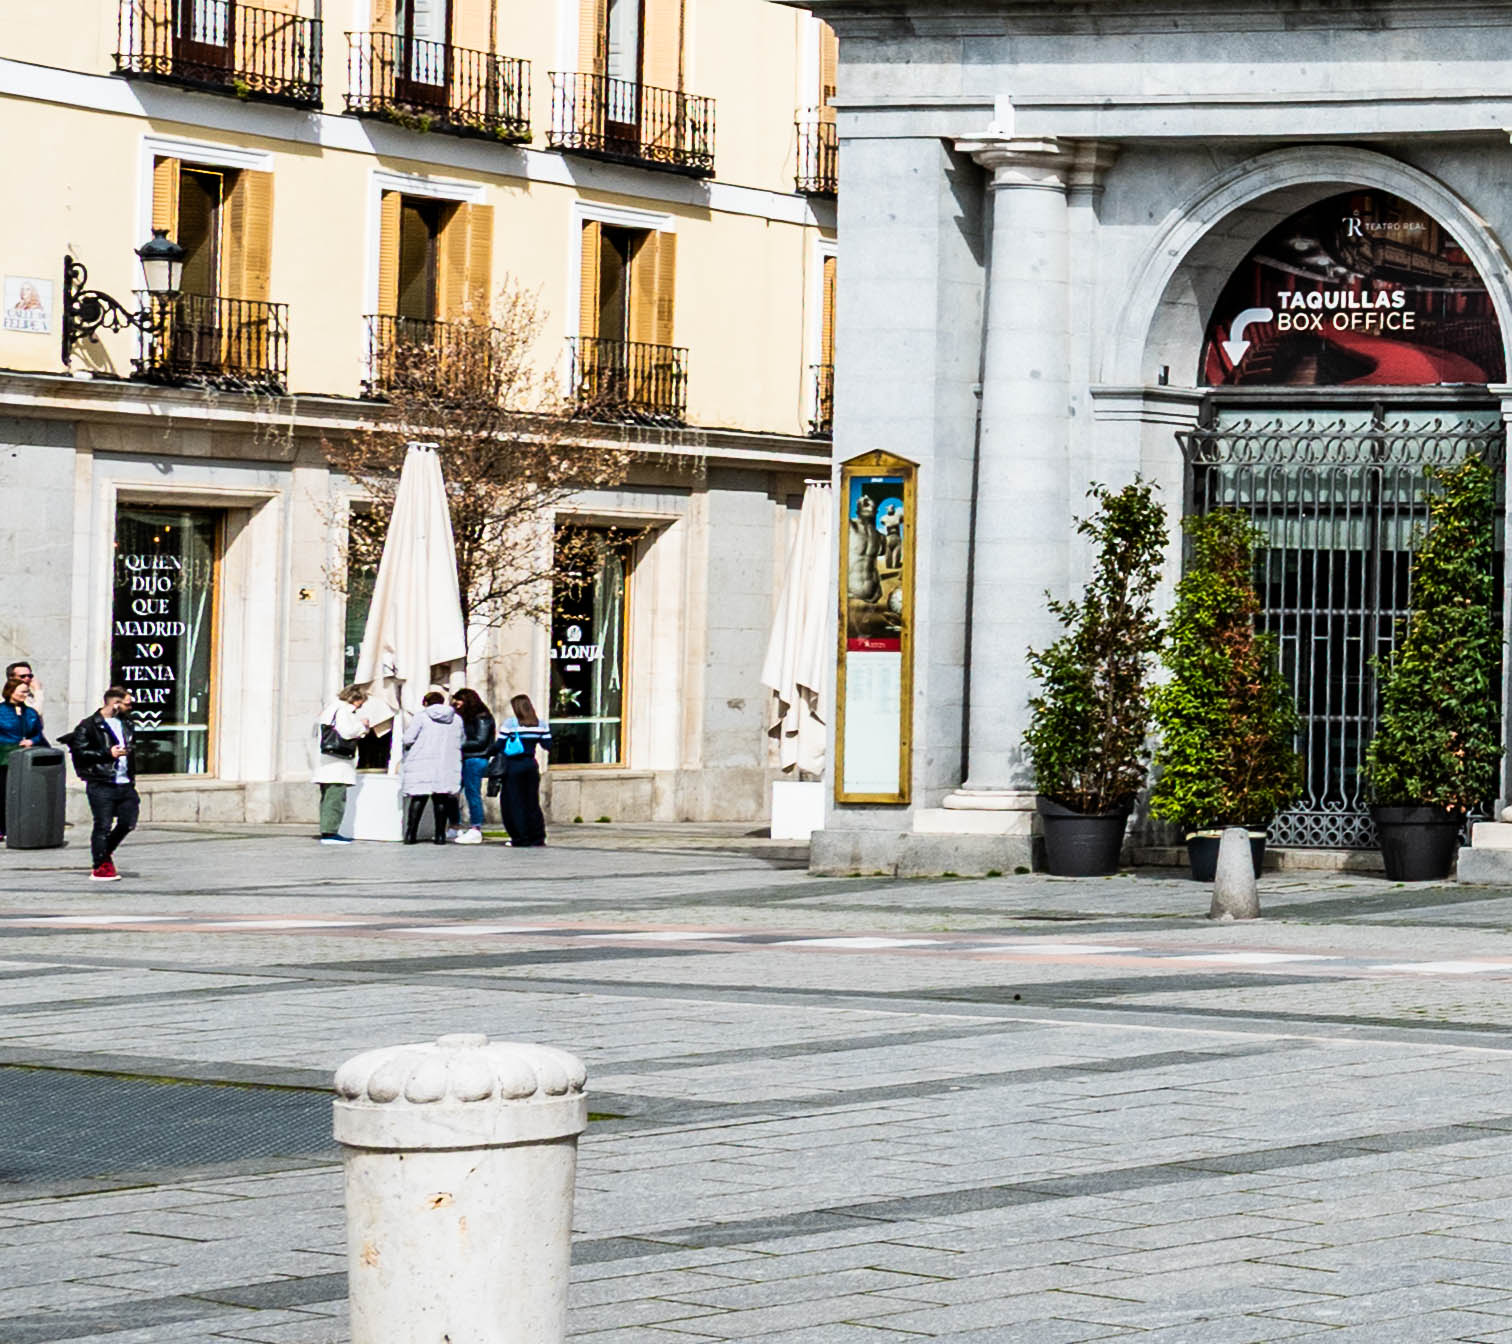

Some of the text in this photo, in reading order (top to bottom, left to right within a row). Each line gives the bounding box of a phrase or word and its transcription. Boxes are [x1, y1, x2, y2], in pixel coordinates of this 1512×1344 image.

[1342, 217, 1427, 237] TR TEATRO REAL
[1277, 290, 1406, 310] TAQUILLAS
[1277, 311, 1416, 332] BOX OFFICE
[131, 576, 171, 595] DIJO
[131, 598, 170, 616] QUE
[114, 620, 186, 637] MADRID
[135, 643, 164, 659] NO
[559, 644, 605, 662] LONJA
